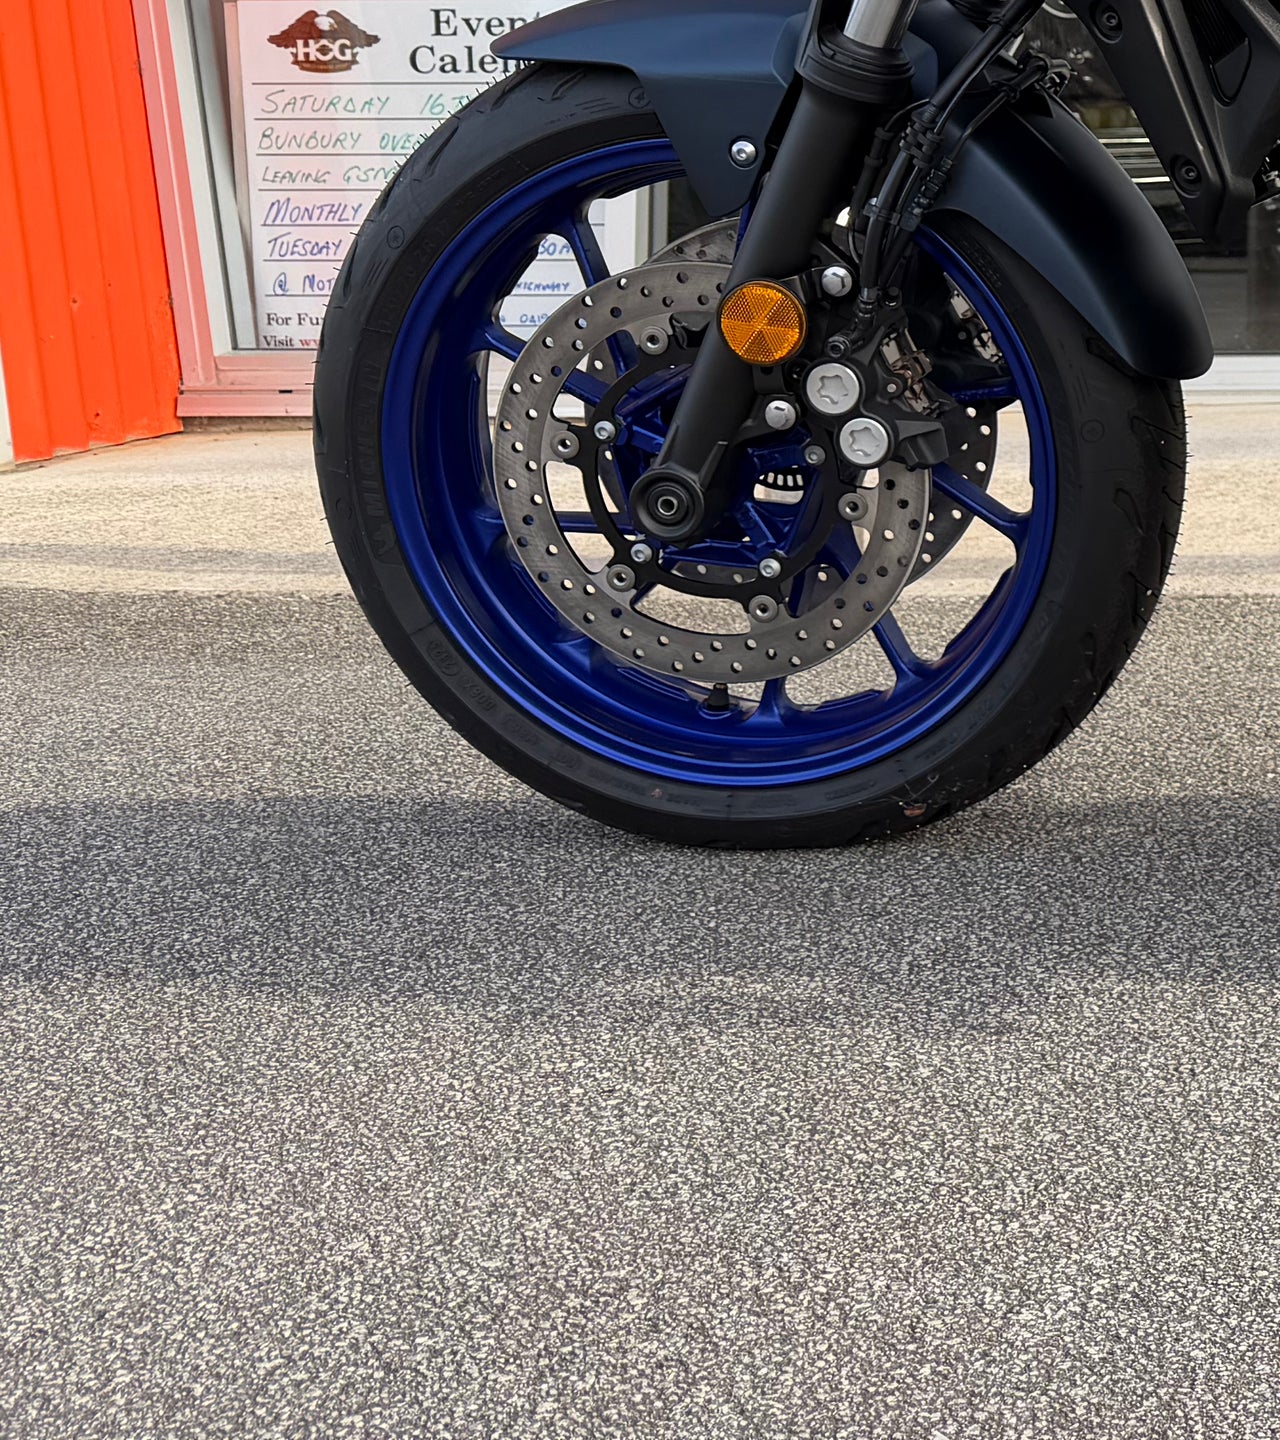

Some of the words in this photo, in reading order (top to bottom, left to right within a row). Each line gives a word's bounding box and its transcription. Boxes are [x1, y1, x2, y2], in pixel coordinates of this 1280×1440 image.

[429, 8, 528, 37] Even
[408, 44, 526, 75] Calen
[261, 89, 391, 114] SATURDAY
[257, 126, 362, 150] BUNBURY
[378, 133, 417, 150] OVE
[261, 166, 331, 184] LEAVING
[264, 197, 363, 226] MONTHLY
[267, 232, 343, 258] TUESDAY
[265, 312, 293, 327] For
[262, 334, 295, 348] Visit
